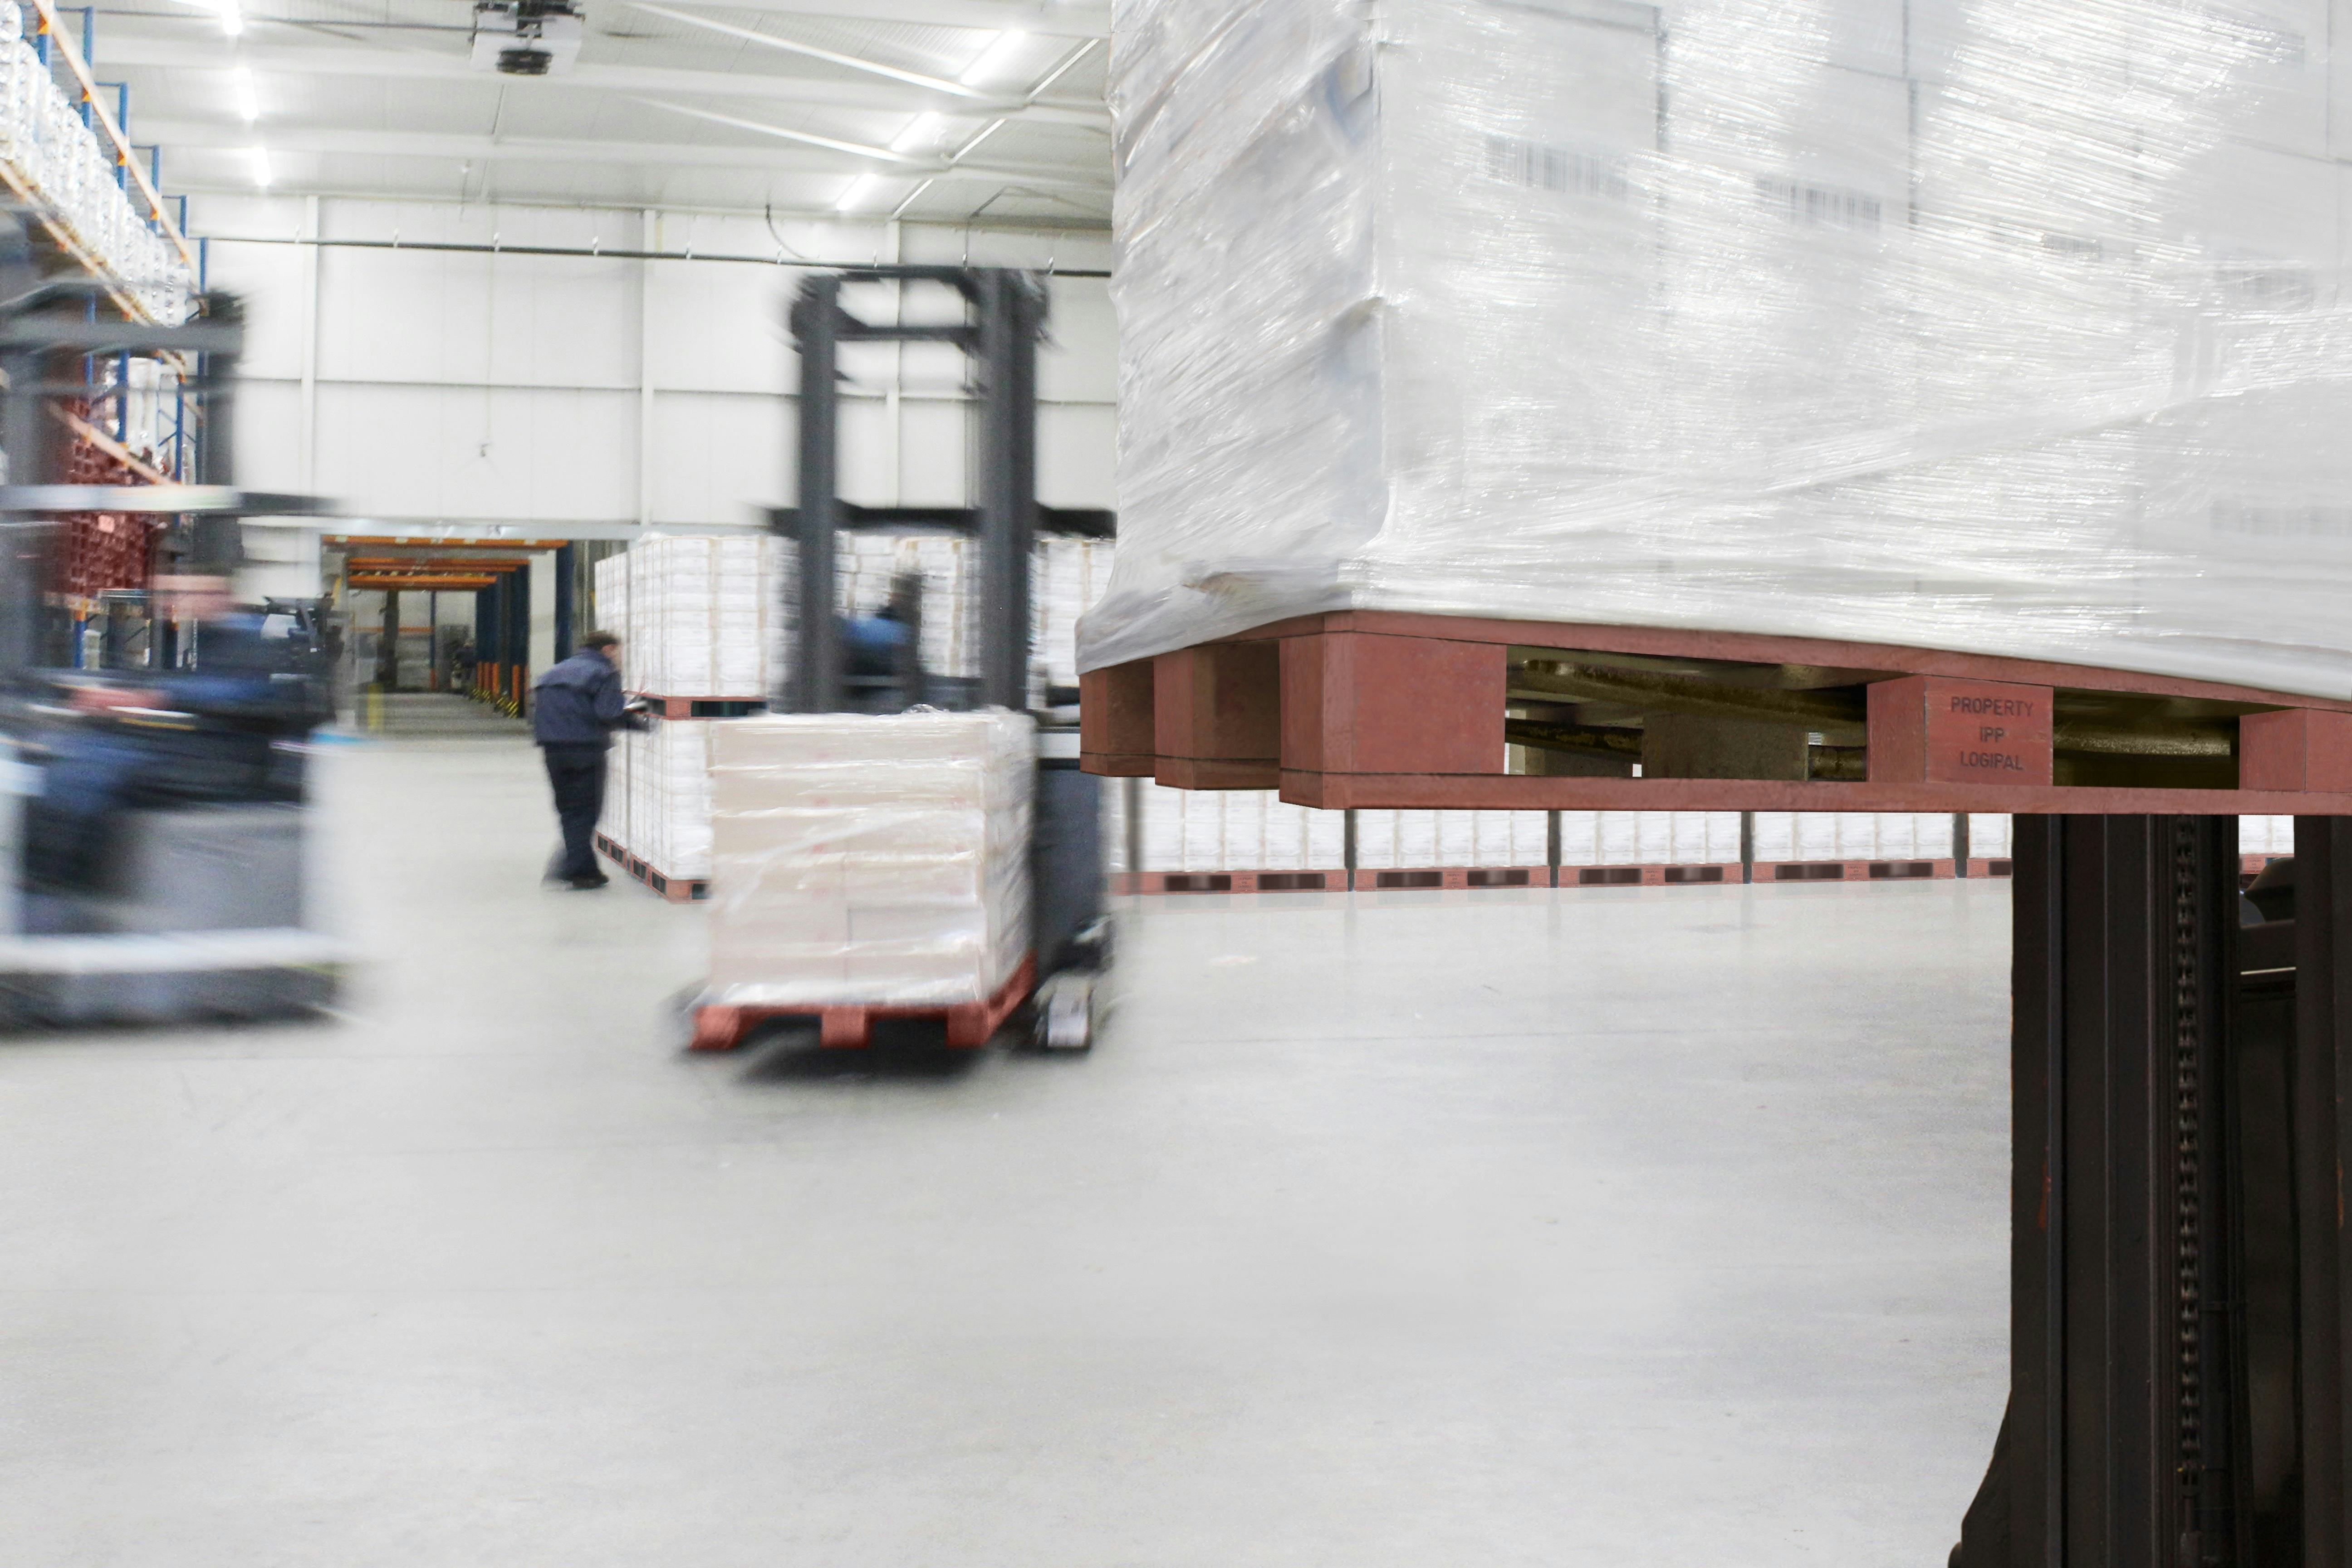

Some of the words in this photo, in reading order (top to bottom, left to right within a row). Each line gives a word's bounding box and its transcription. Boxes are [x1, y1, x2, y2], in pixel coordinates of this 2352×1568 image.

[1951, 696, 2033, 716] PROPERTY
[1980, 726, 2004, 742] IPP
[1960, 751, 2023, 770] LOGIPAL
